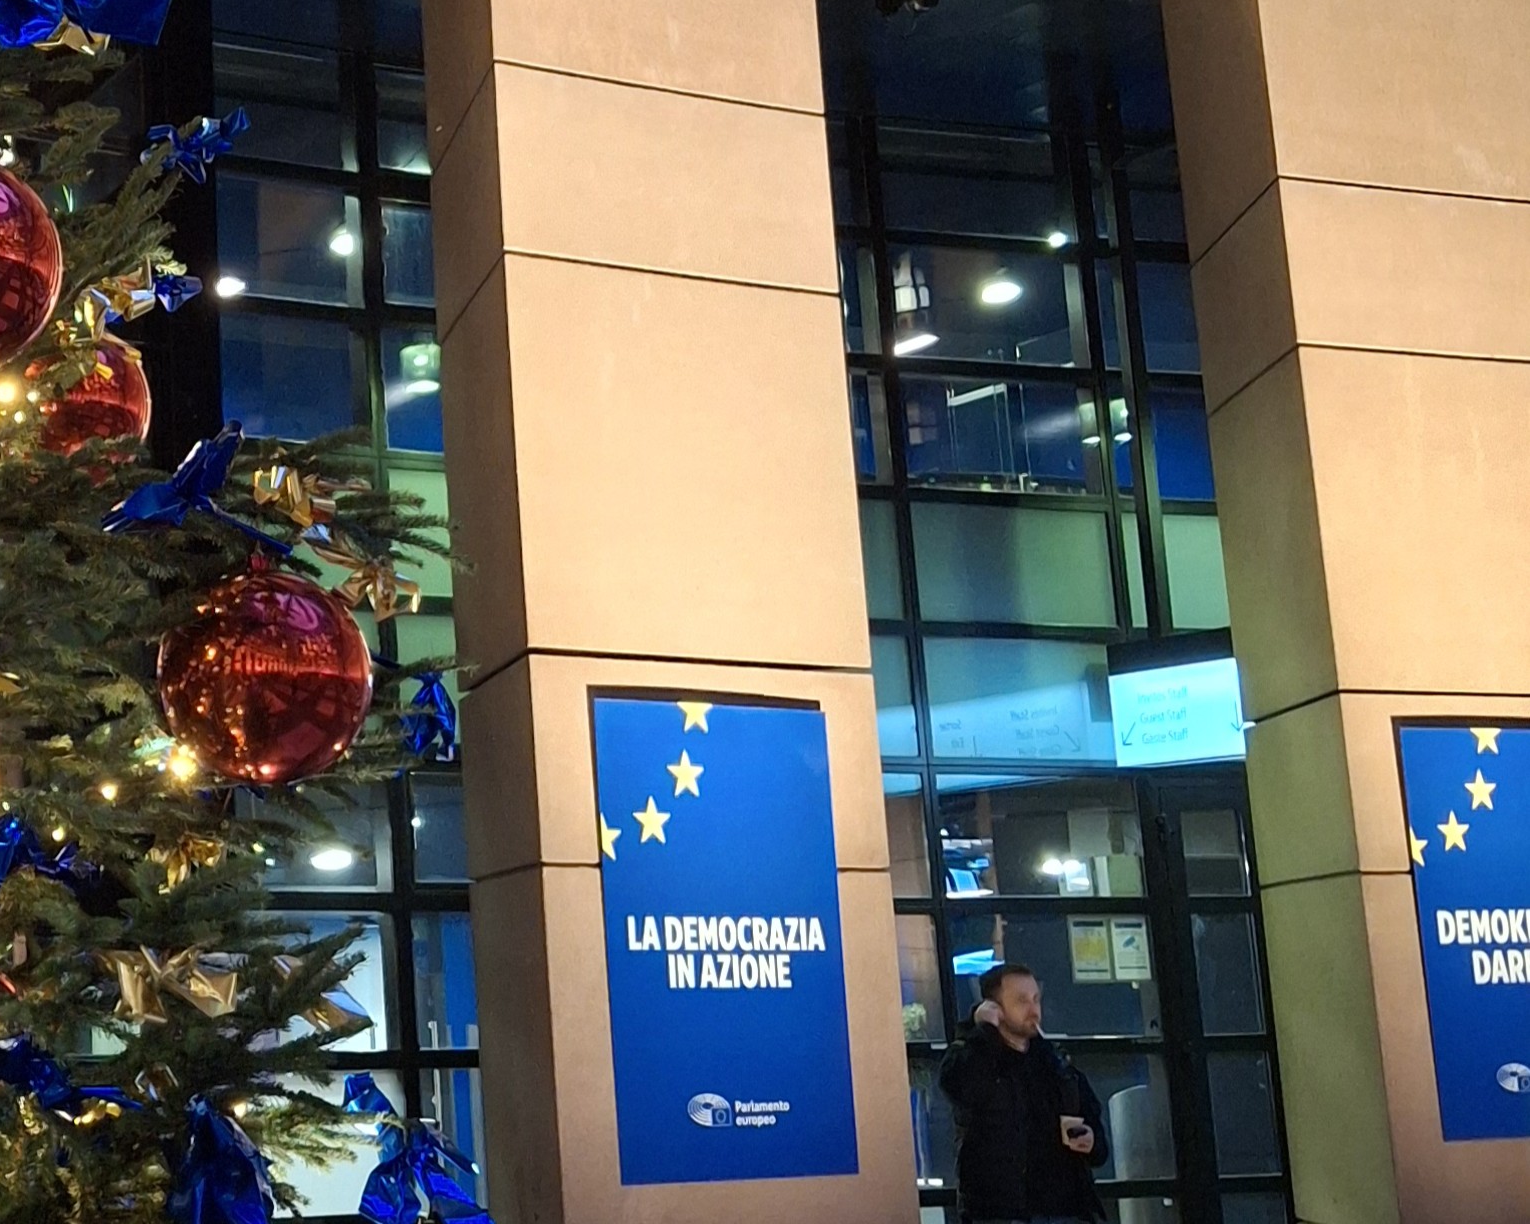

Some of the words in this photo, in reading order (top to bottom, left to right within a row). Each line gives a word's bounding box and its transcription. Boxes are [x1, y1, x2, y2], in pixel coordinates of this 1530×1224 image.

[1167, 707, 1187, 721] Staff
[1168, 727, 1188, 742] Staff
[628, 916, 661, 950] LA
[665, 916, 825, 951] DEMOCRAZIA
[1437, 909, 1530, 944] DEMOK
[668, 954, 695, 988] IN
[701, 954, 791, 988] AZIONE
[735, 1100, 789, 1112] Parlamento
[736, 1115, 776, 1127] europeo
